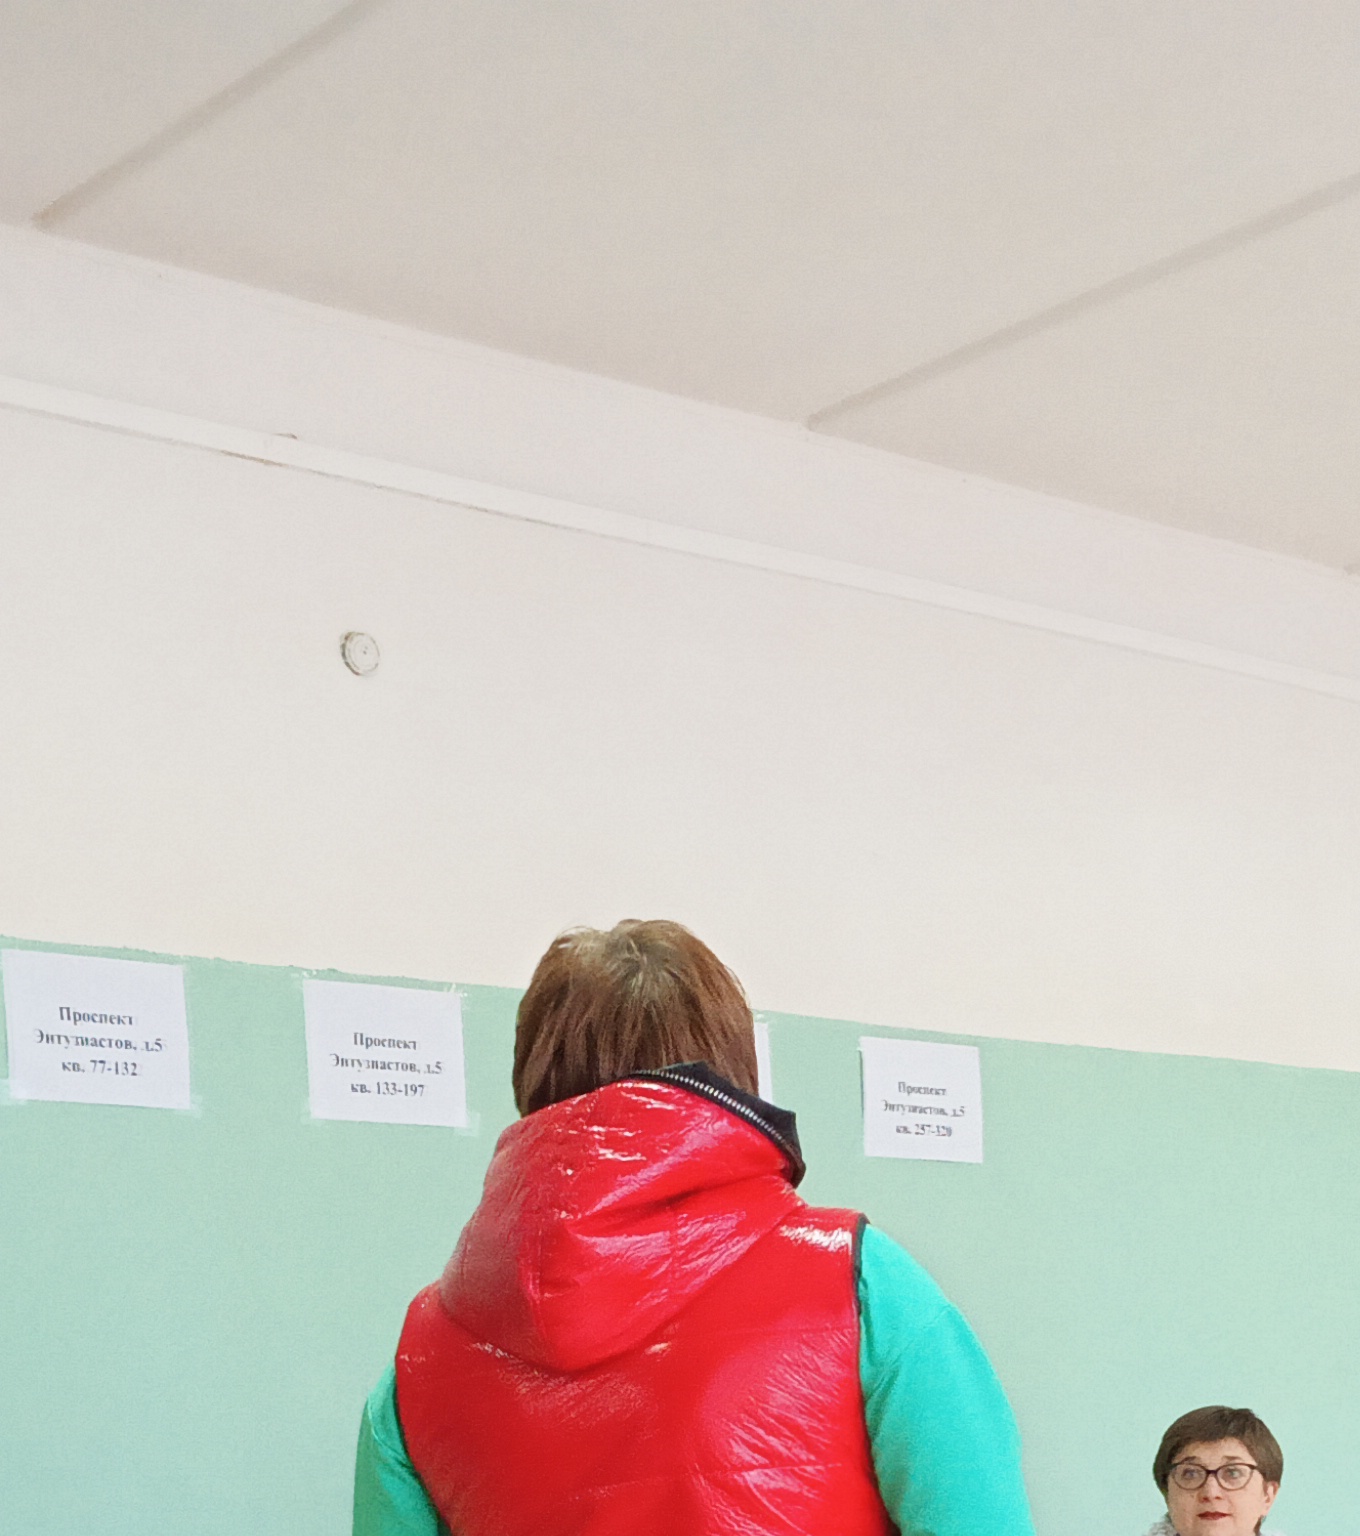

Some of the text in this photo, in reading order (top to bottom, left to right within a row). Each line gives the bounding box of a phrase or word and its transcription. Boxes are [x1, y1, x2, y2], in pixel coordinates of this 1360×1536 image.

[58, 1006, 134, 1027] Проспект
[34, 1028, 138, 1051] Энтузиастов,
[352, 1032, 417, 1050] Проспект
[61, 1059, 139, 1077] кв. 77-132
[329, 1053, 421, 1075] Энтузиастов,
[350, 1081, 425, 1097] кв. 133-197
[897, 1081, 948, 1096] Проспект
